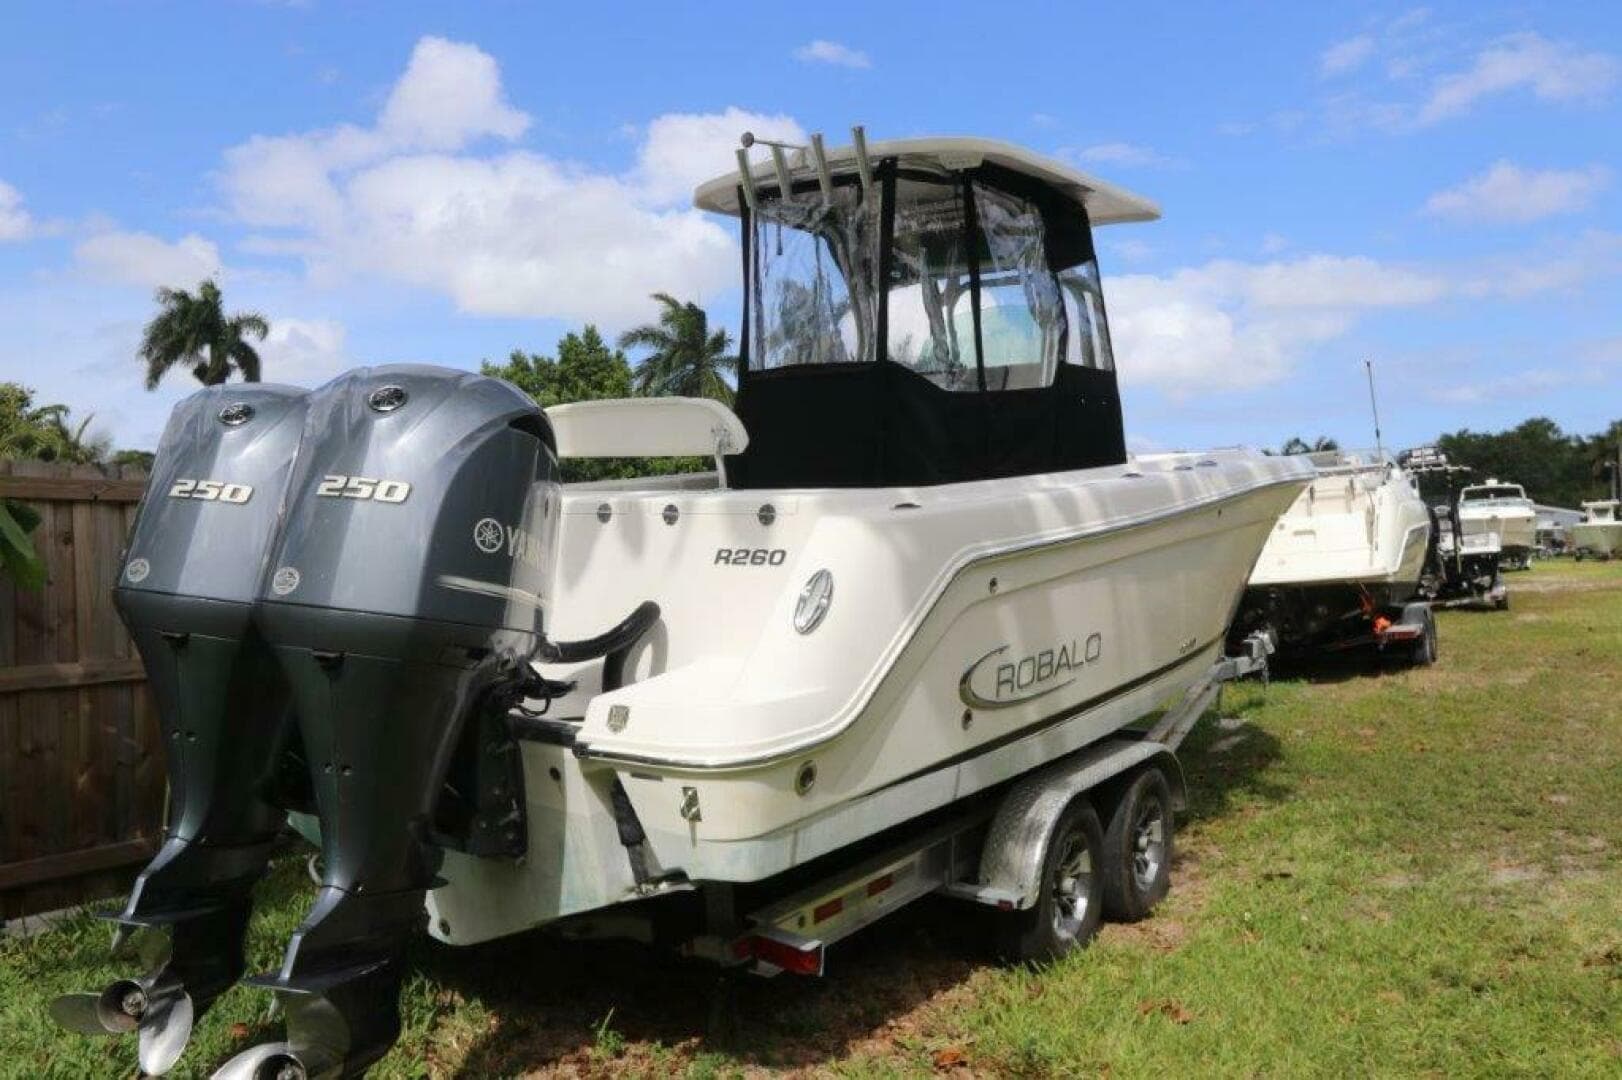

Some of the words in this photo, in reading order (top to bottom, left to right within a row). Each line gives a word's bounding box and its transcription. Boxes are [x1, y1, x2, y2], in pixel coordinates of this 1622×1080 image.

[167, 479, 254, 504] 250
[316, 474, 411, 504] 250
[714, 548, 787, 567] R260
[996, 631, 1102, 699] ROBALO
